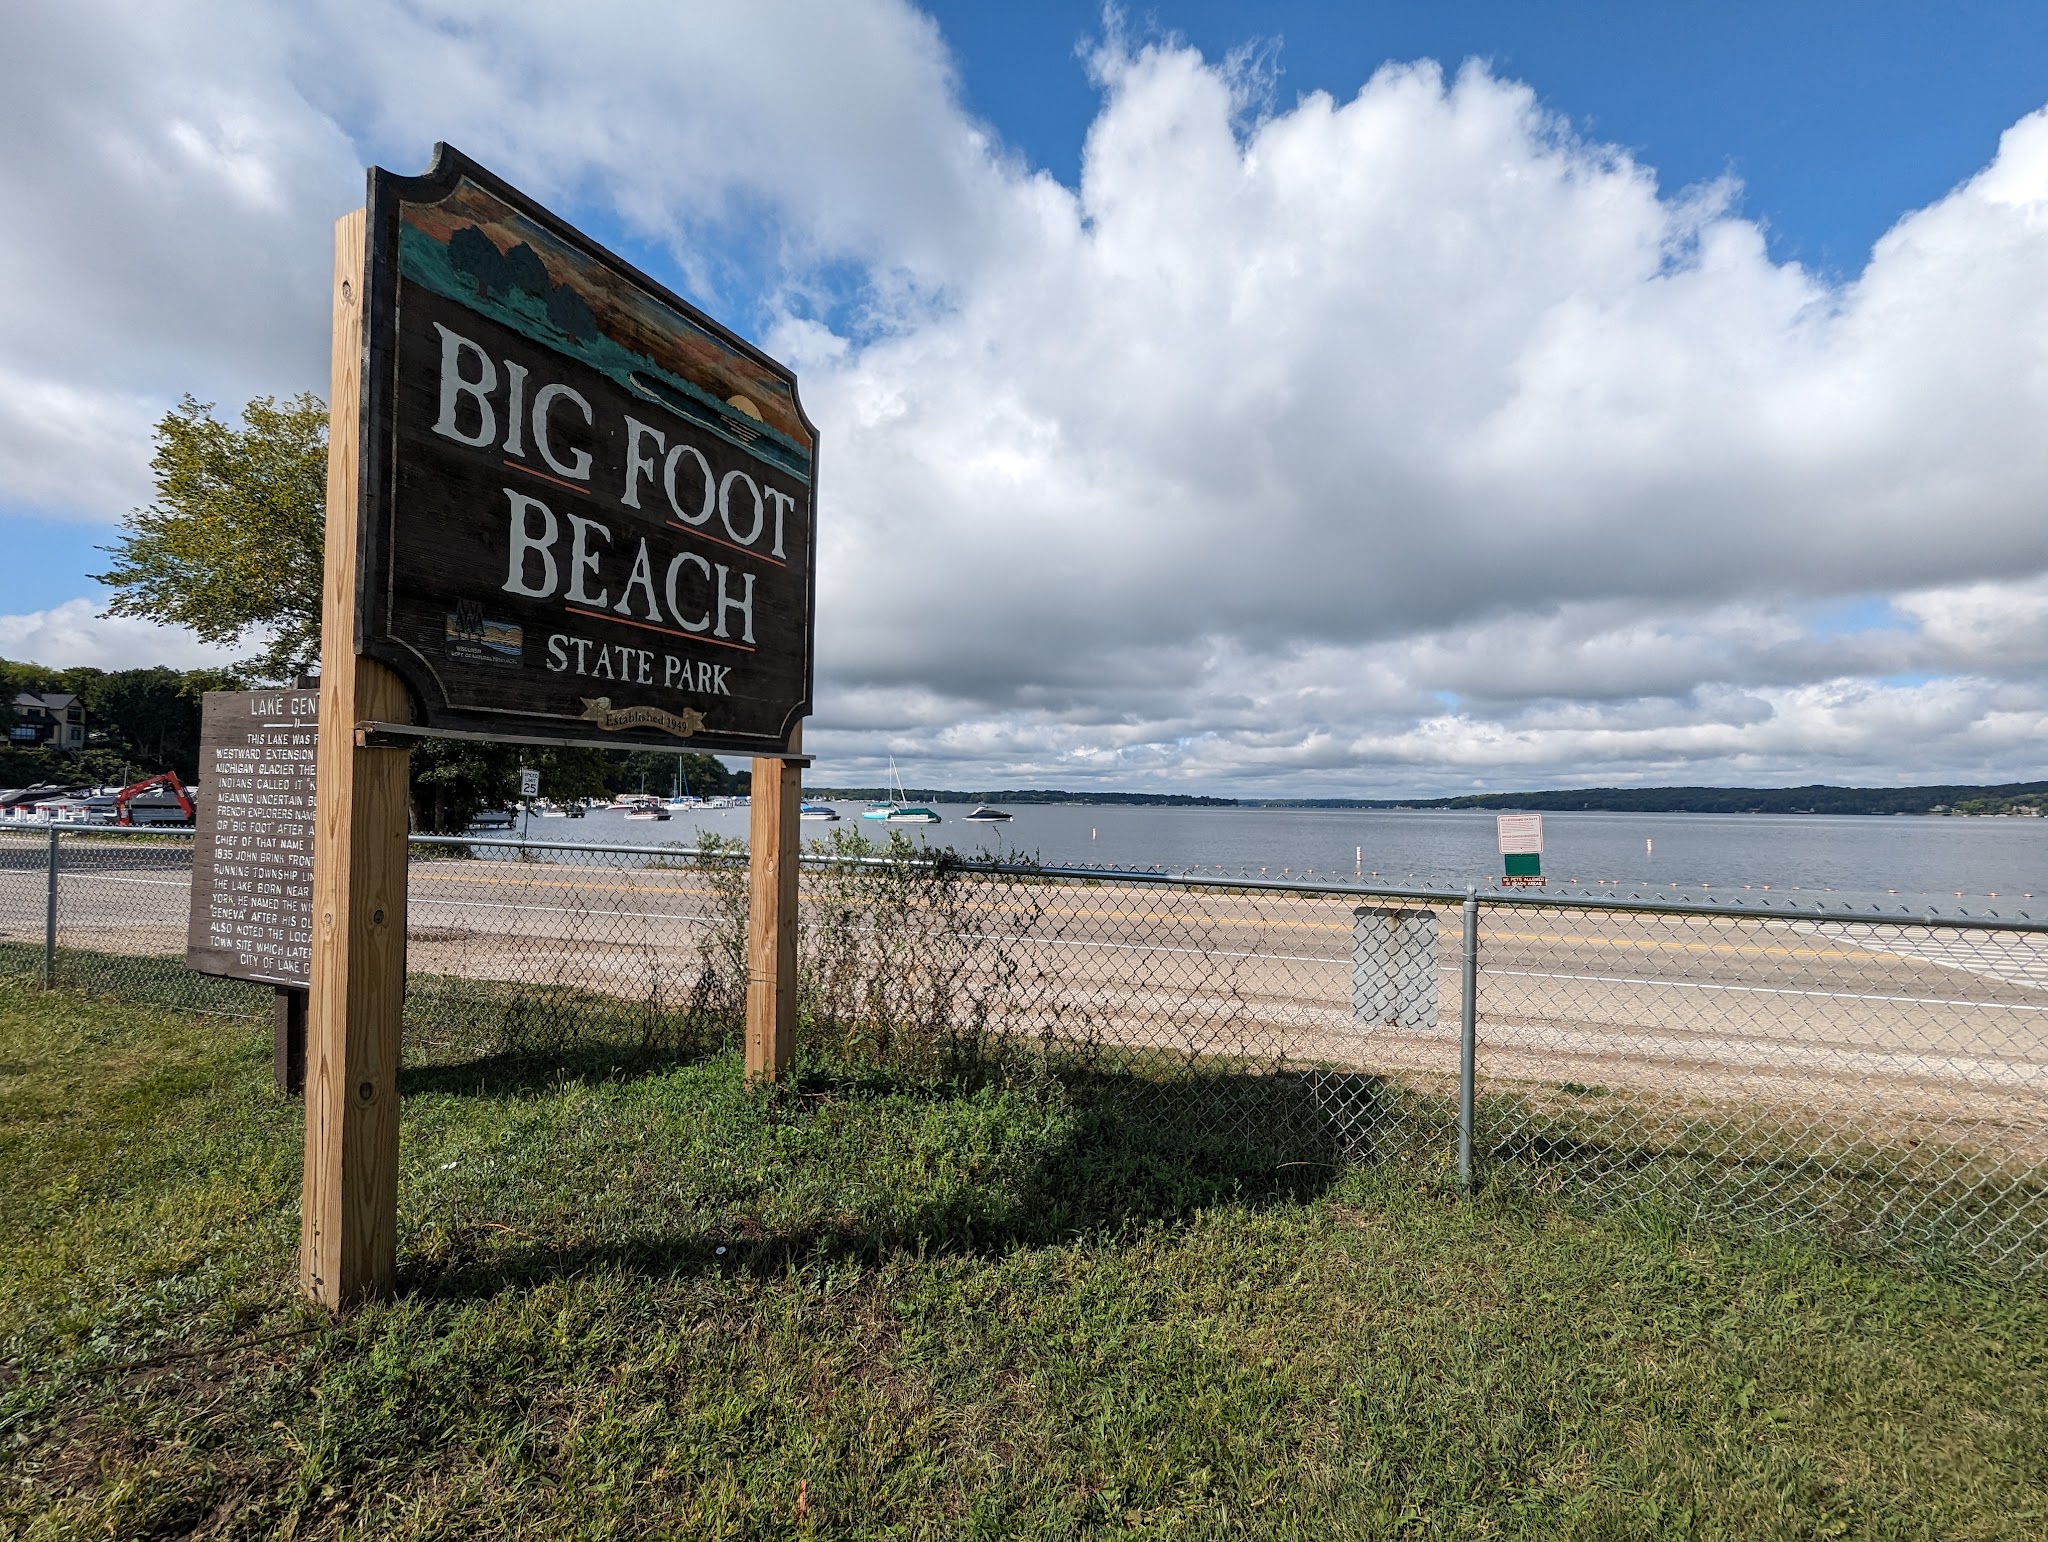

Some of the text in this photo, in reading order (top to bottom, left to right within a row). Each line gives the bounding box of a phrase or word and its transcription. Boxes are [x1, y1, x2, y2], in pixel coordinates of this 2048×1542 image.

[431, 321, 794, 560] BIG FOOT
[501, 487, 757, 644] BEACH
[546, 634, 732, 696] STATE PARK
[251, 698, 284, 715] LAKE
[605, 712, 687, 733] Established 1949
[247, 733, 265, 745] THIS
[267, 734, 289, 745] LAKE
[292, 734, 311, 745] WAS
[216, 748, 314, 760] WESTWARD EXTENSION
[215, 763, 316, 776] MICHIGAN GLACIER THE
[218, 778, 252, 789] INDIANS
[256, 779, 290, 790] CALLED
[294, 779, 303, 790] IT
[524, 783, 536, 793] 25
[217, 793, 254, 804] MEANING
[256, 794, 303, 806] UNCERTAIN
[217, 805, 317, 821] FRENCH EXPLORERS NAME
[216, 820, 228, 830] OR
[277, 824, 304, 835] AFTER
[215, 835, 238, 846] CHIEF
[241, 837, 253, 847] OF
[256, 837, 277, 848] THAT
[280, 840, 304, 851] NAME
[214, 849, 315, 867] 1835 JOHN BRINK FRONT
[213, 864, 250, 877] RUNNING
[253, 867, 298, 881] TOWNSHIP
[213, 879, 309, 897] THE LAKE BORN NEAR
[212, 893, 236, 907] YORK,
[238, 896, 249, 906] HE
[251, 897, 279, 910] NAMED
[282, 900, 297, 912] THE
[251, 912, 278, 924] AFTER
[282, 915, 297, 927] HIS
[210, 922, 233, 934] ALSO
[236, 925, 264, 938] NOTED
[268, 928, 284, 940] THE
[210, 936, 233, 948] TOWN
[236, 939, 253, 952] SITE
[256, 942, 284, 955] WHICH
[240, 953, 259, 967] CITY
[263, 957, 274, 969] OF
[278, 959, 300, 973] LAKE
